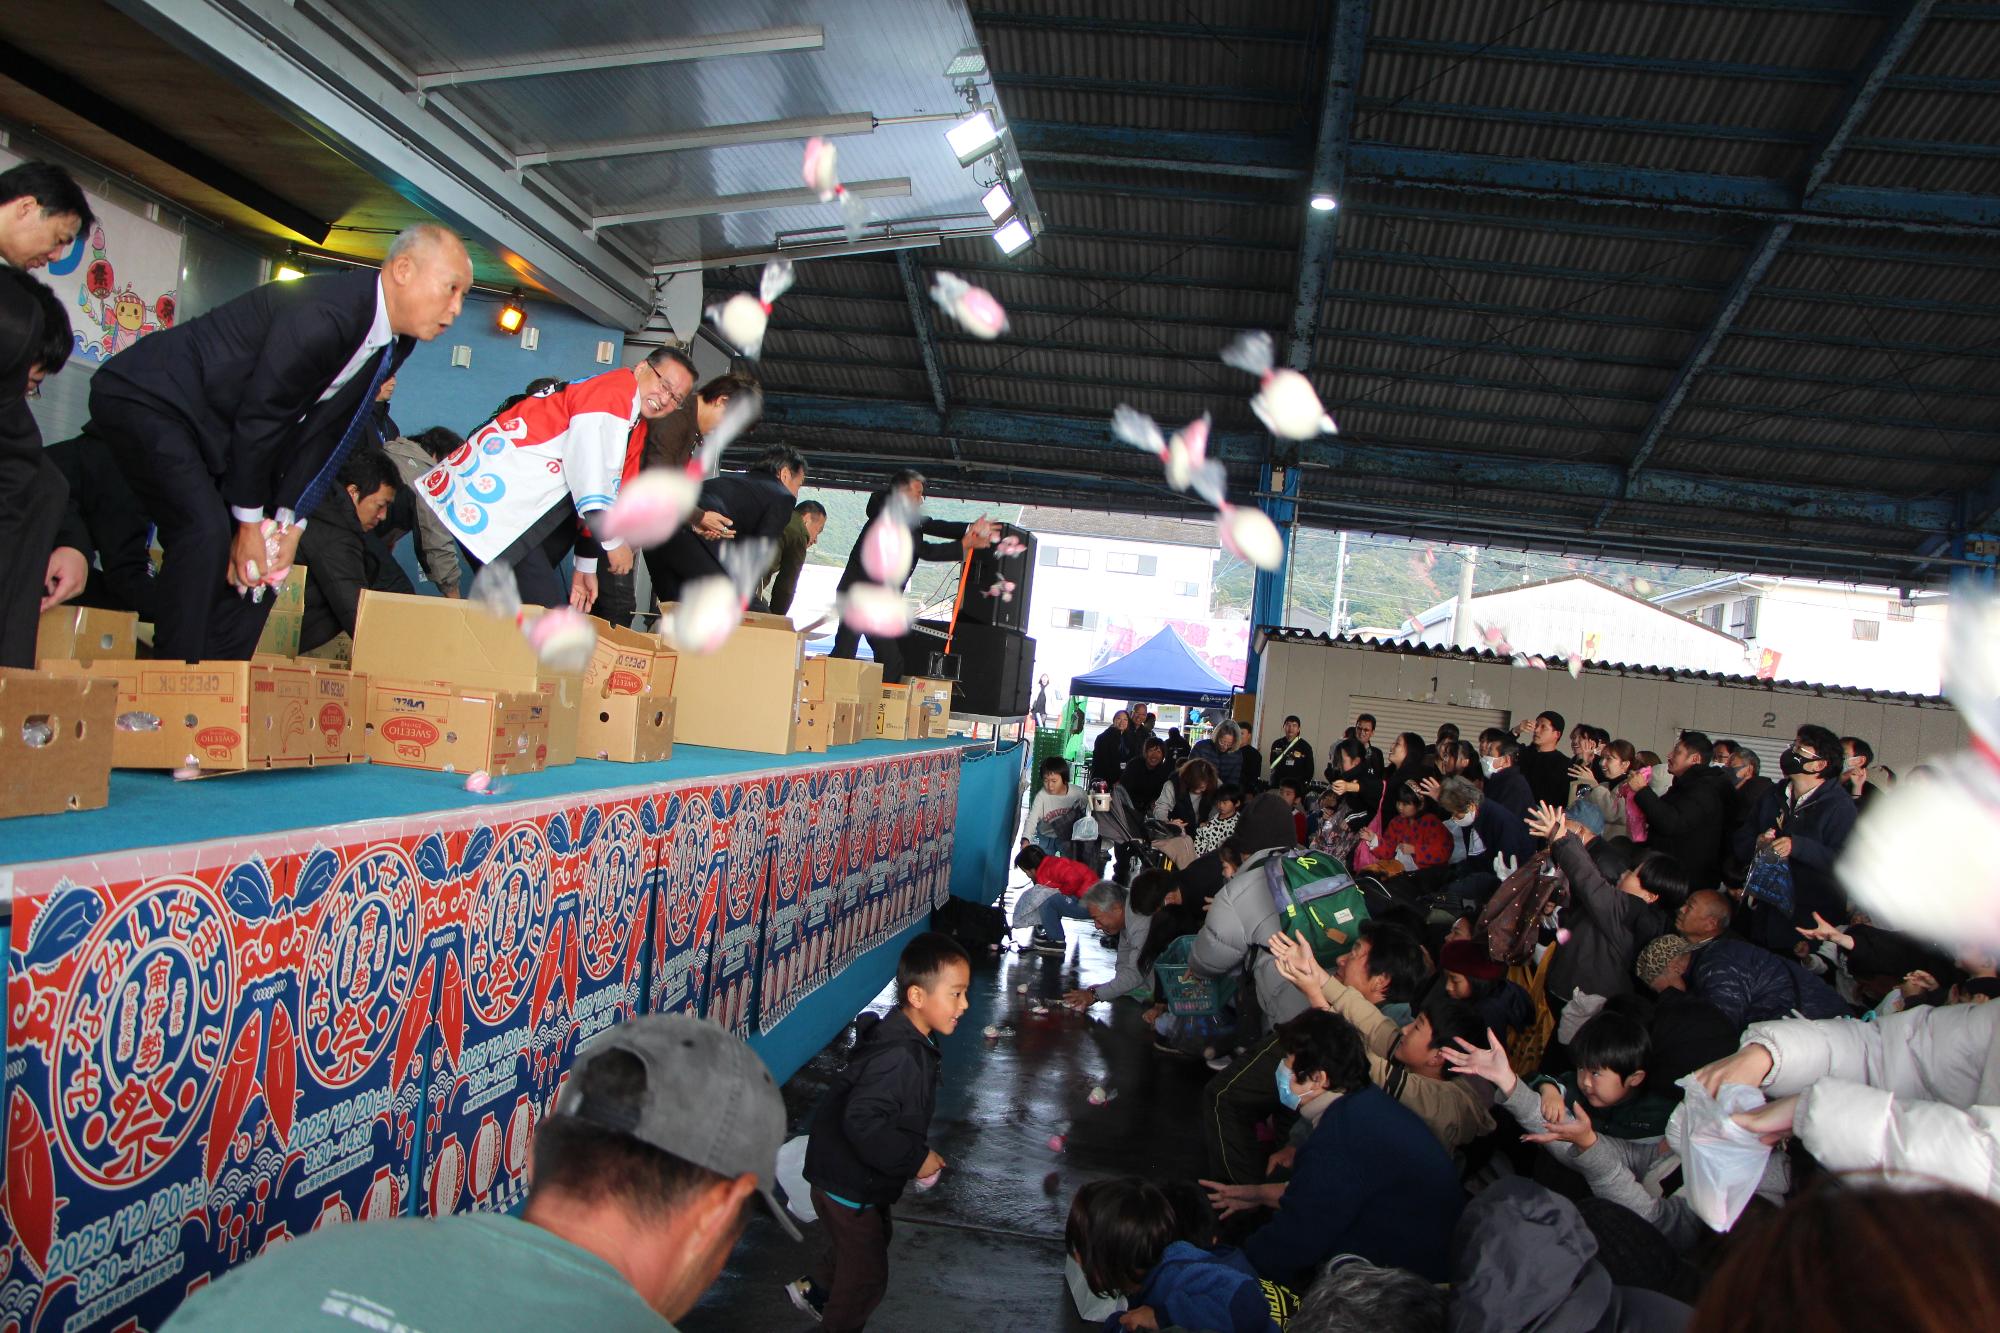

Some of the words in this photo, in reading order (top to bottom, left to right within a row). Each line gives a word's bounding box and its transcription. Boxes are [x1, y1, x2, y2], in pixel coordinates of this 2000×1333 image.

[180, 675, 220, 691] CPE25
[1431, 676, 1438, 692] 1
[1762, 712, 1776, 728] 2
[201, 735, 235, 744] SWEETIO
[388, 725, 432, 740] SWEETIO
[209, 748, 228, 758] Dole
[398, 744, 421, 758] Dole
[307, 855, 415, 1030] みなみいせまつり
[65, 888, 224, 1118] みなみいせまつり
[287, 1085, 394, 1152] 2025/12/20(土)
[45, 1176, 208, 1282] 2025/12/20(土)
